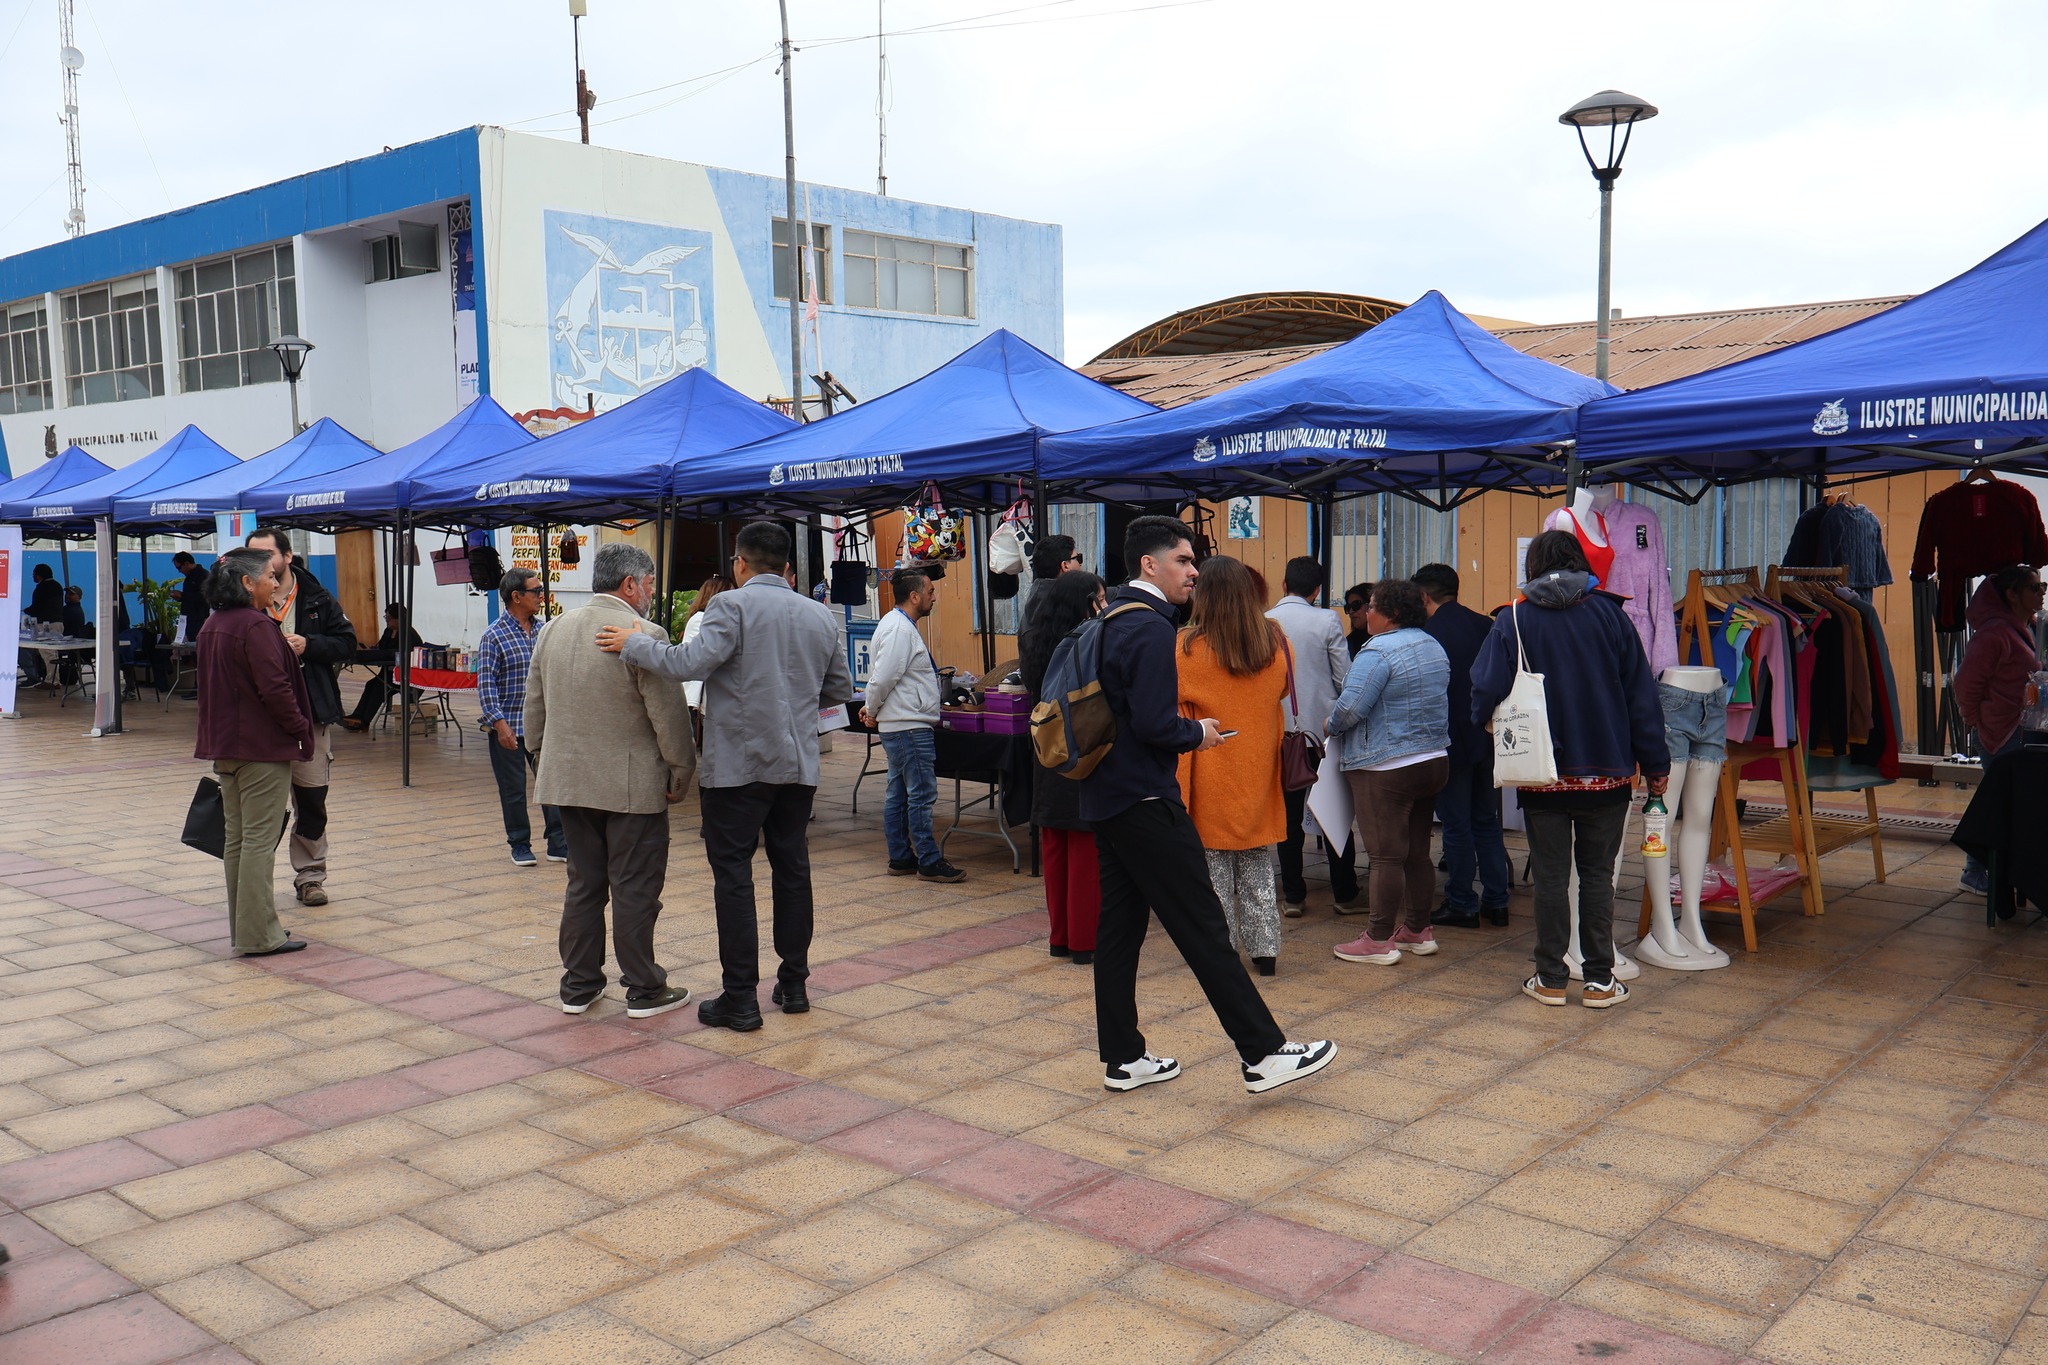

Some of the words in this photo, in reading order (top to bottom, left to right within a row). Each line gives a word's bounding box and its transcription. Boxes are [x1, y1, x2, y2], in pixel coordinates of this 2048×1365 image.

[1861, 397, 1926, 428] ILUSTRE
[68, 433, 125, 446] MUNICIPALIDAD
[130, 430, 158, 442] TALTAL
[1221, 432, 1263, 456] ILUSTRE
[1266, 428, 1336, 452] MUNICIPALIDAD
[1338, 428, 1351, 449] DE
[1353, 428, 1387, 448] TALTAL
[788, 463, 815, 481] ILUSTRE
[816, 458, 866, 479] MUNICIPALIDAD
[867, 456, 877, 474] DE
[879, 454, 904, 473] TALTAL
